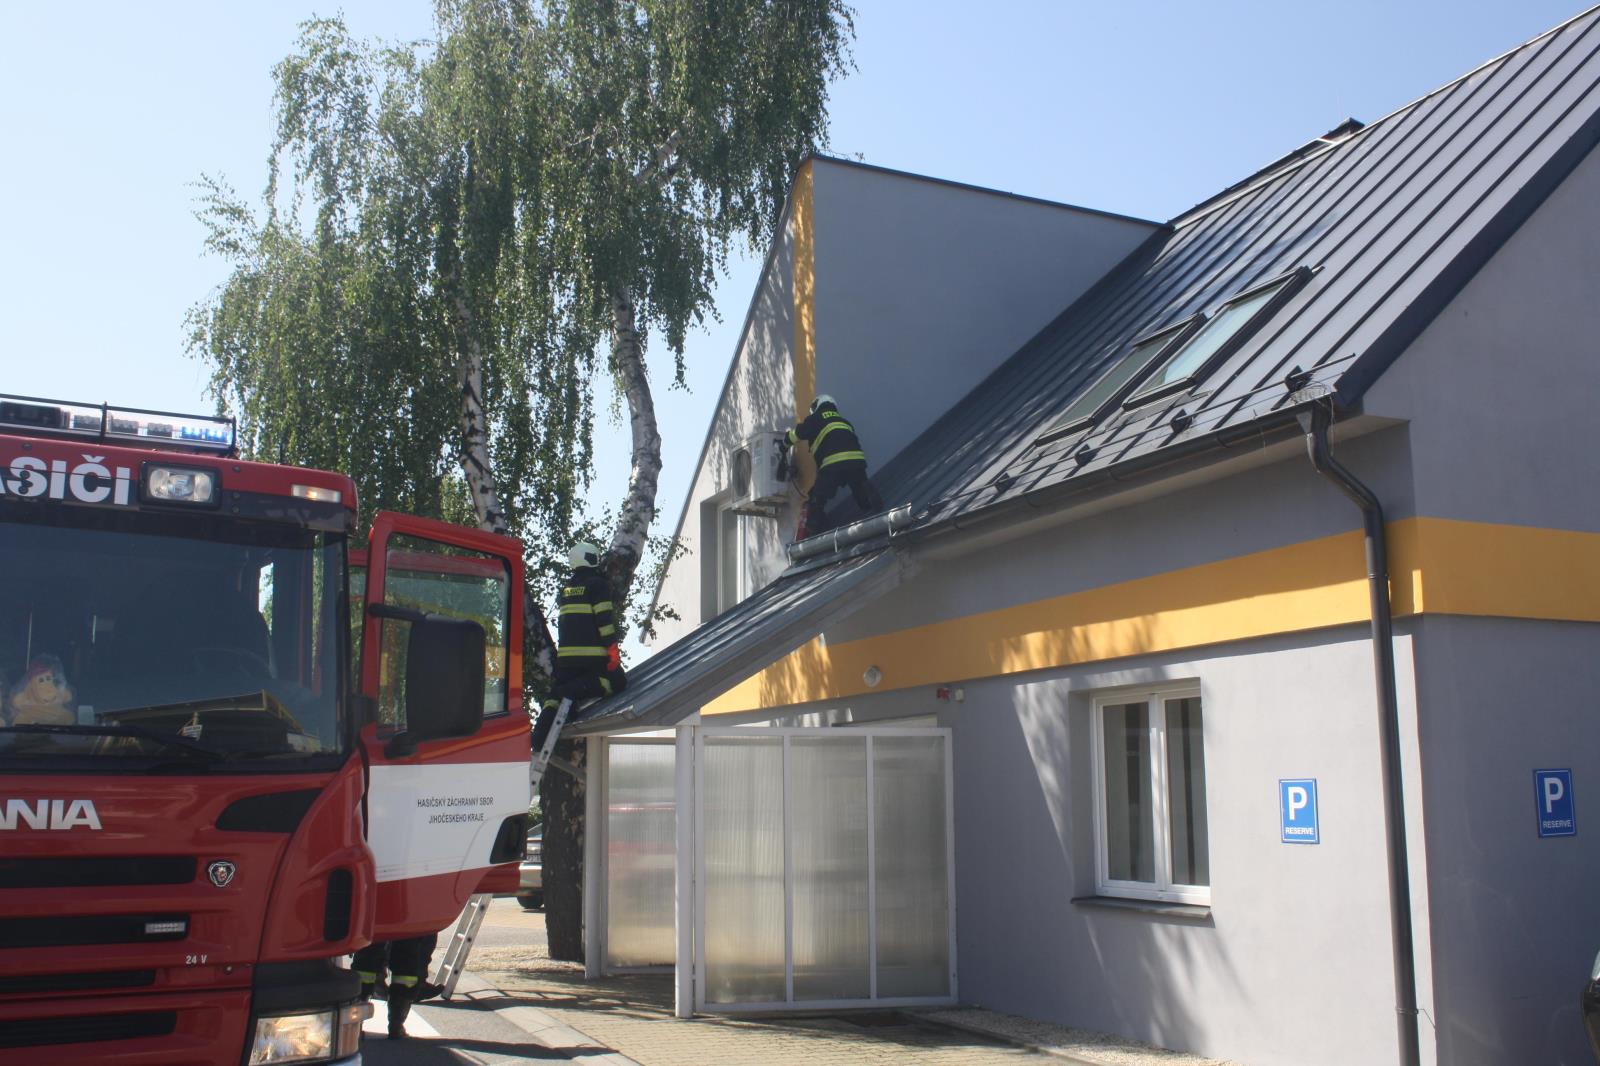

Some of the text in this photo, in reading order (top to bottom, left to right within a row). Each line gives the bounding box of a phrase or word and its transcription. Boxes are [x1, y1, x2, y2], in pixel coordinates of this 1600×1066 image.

[0, 454, 131, 505] SIČI
[1544, 777, 1563, 813] P
[480, 796, 494, 806] SBOR
[1288, 786, 1308, 820] P
[0, 799, 103, 830] NIA
[467, 813, 485, 823] KRAJE
[1542, 820, 1573, 829] RESERVE
[1285, 827, 1315, 835] RESERVE
[185, 954, 208, 965] 24 V
